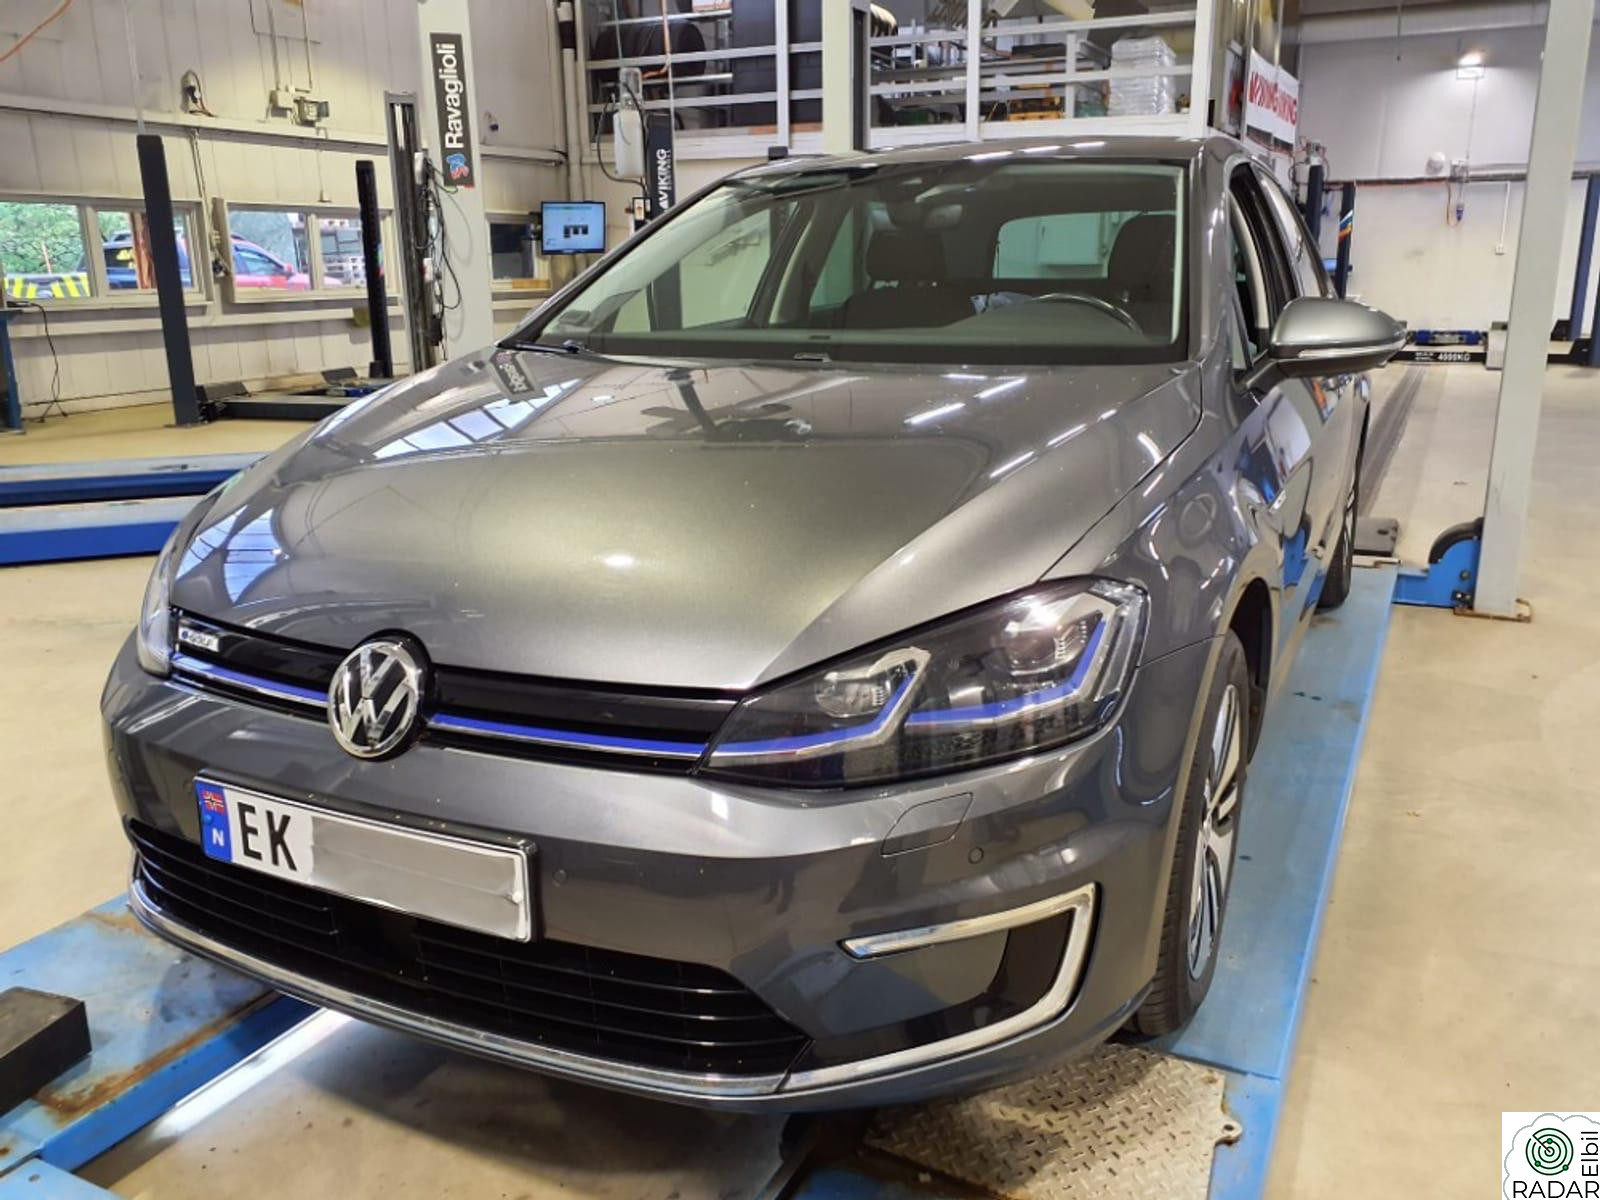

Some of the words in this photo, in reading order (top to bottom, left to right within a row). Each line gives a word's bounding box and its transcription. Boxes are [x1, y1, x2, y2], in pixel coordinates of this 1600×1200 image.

[437, 43, 464, 149] Ravaglioli
[211, 828, 225, 847] N
[237, 801, 298, 872] EK
